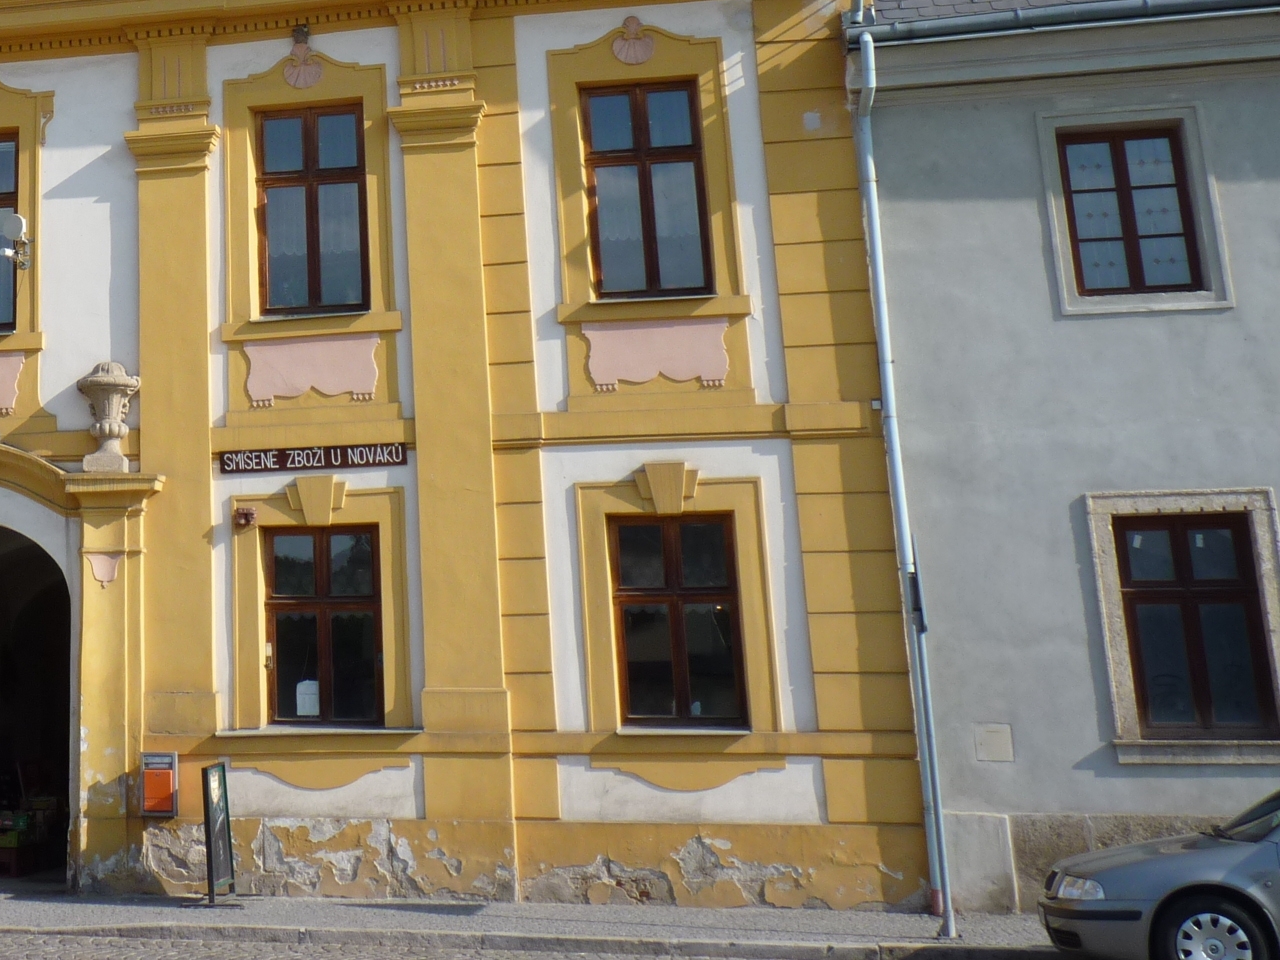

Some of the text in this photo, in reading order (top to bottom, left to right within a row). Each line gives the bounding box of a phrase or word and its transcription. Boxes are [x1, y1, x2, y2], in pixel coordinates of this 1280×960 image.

[224, 443, 402, 470] SMÍŠENÉ ZBOŽÍ U NOVÁKŮ
